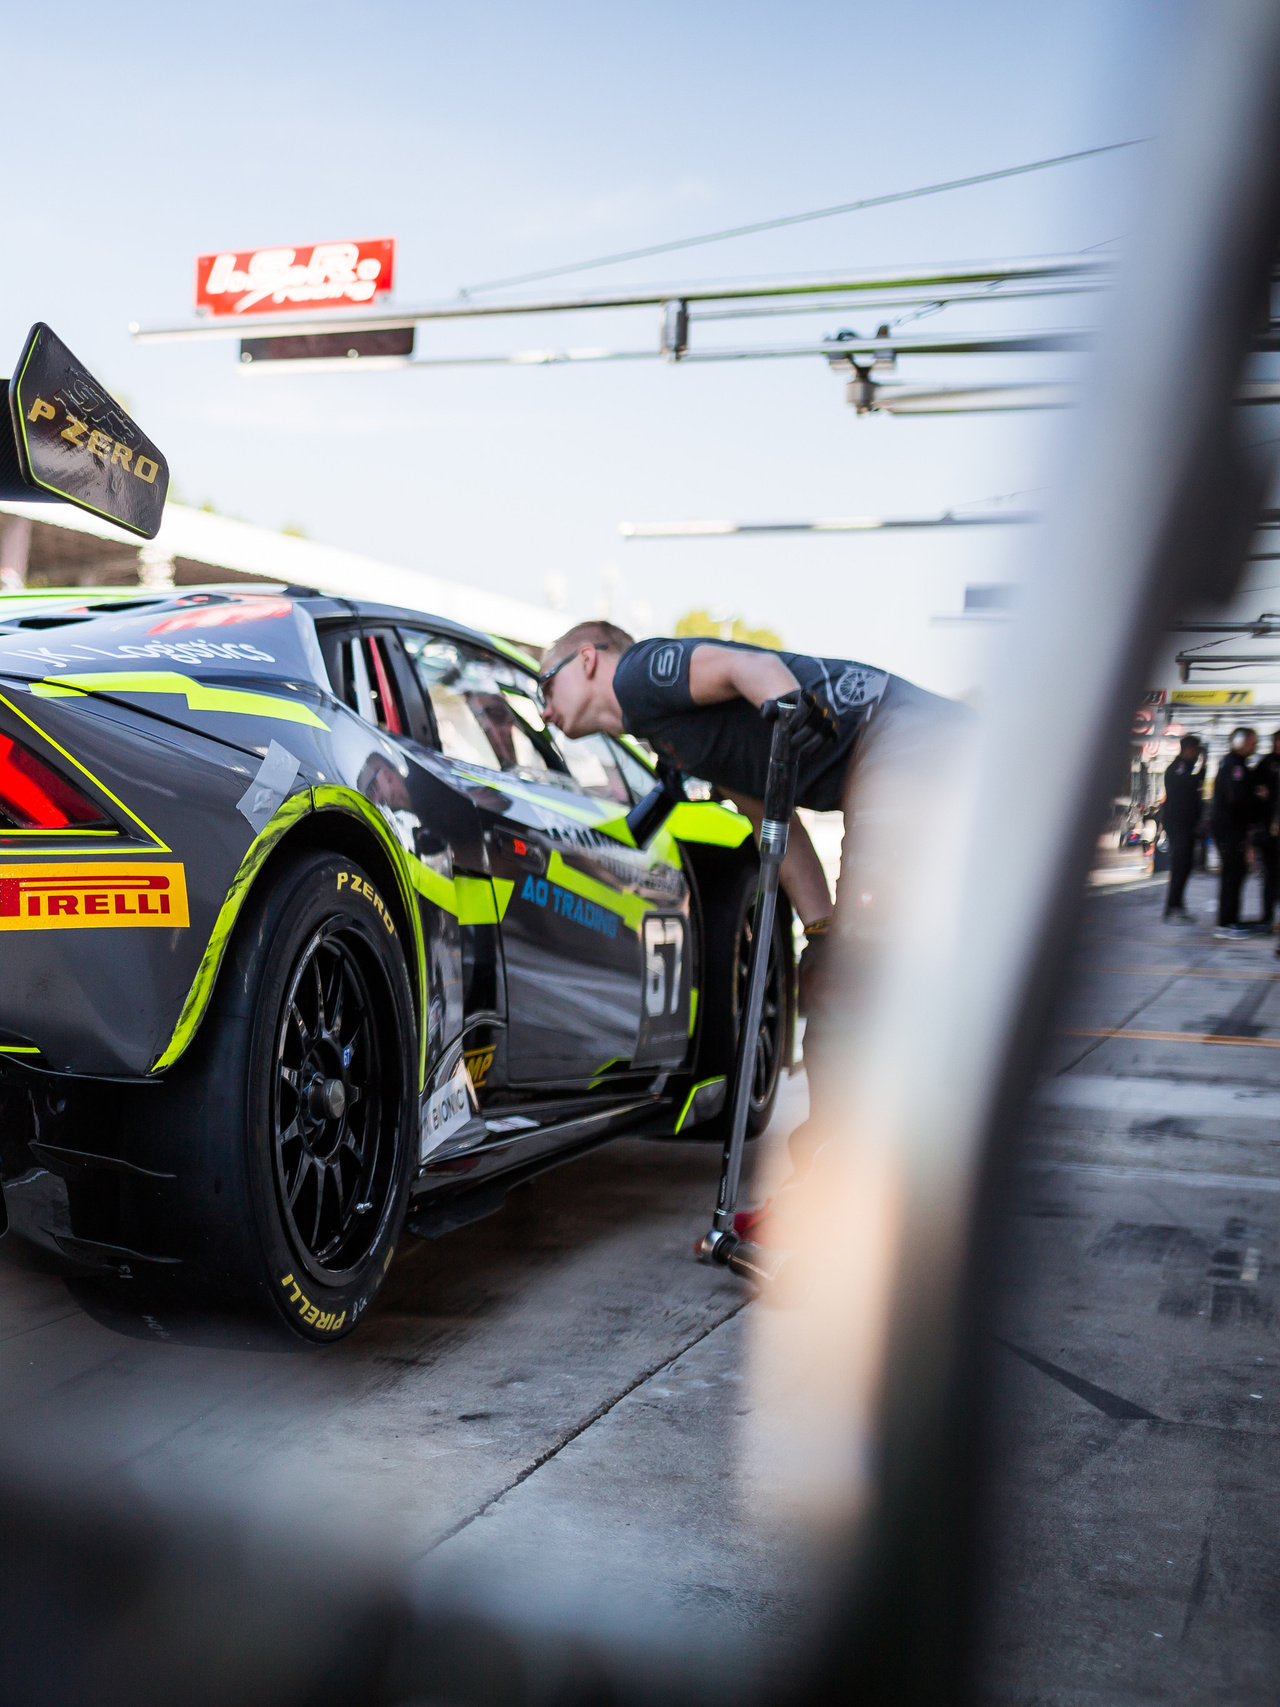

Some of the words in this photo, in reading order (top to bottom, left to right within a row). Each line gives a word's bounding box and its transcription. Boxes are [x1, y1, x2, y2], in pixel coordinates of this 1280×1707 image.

[27, 398, 56, 422] P
[60, 414, 159, 484] ZERO
[70, 638, 276, 665] Logistics
[0, 875, 171, 918] PIRELLI
[350, 873, 395, 935] ZERO
[521, 873, 549, 908] AO
[552, 885, 619, 940] TRADING
[644, 917, 684, 1018] 67
[281, 1273, 347, 1331] PIRELLI
